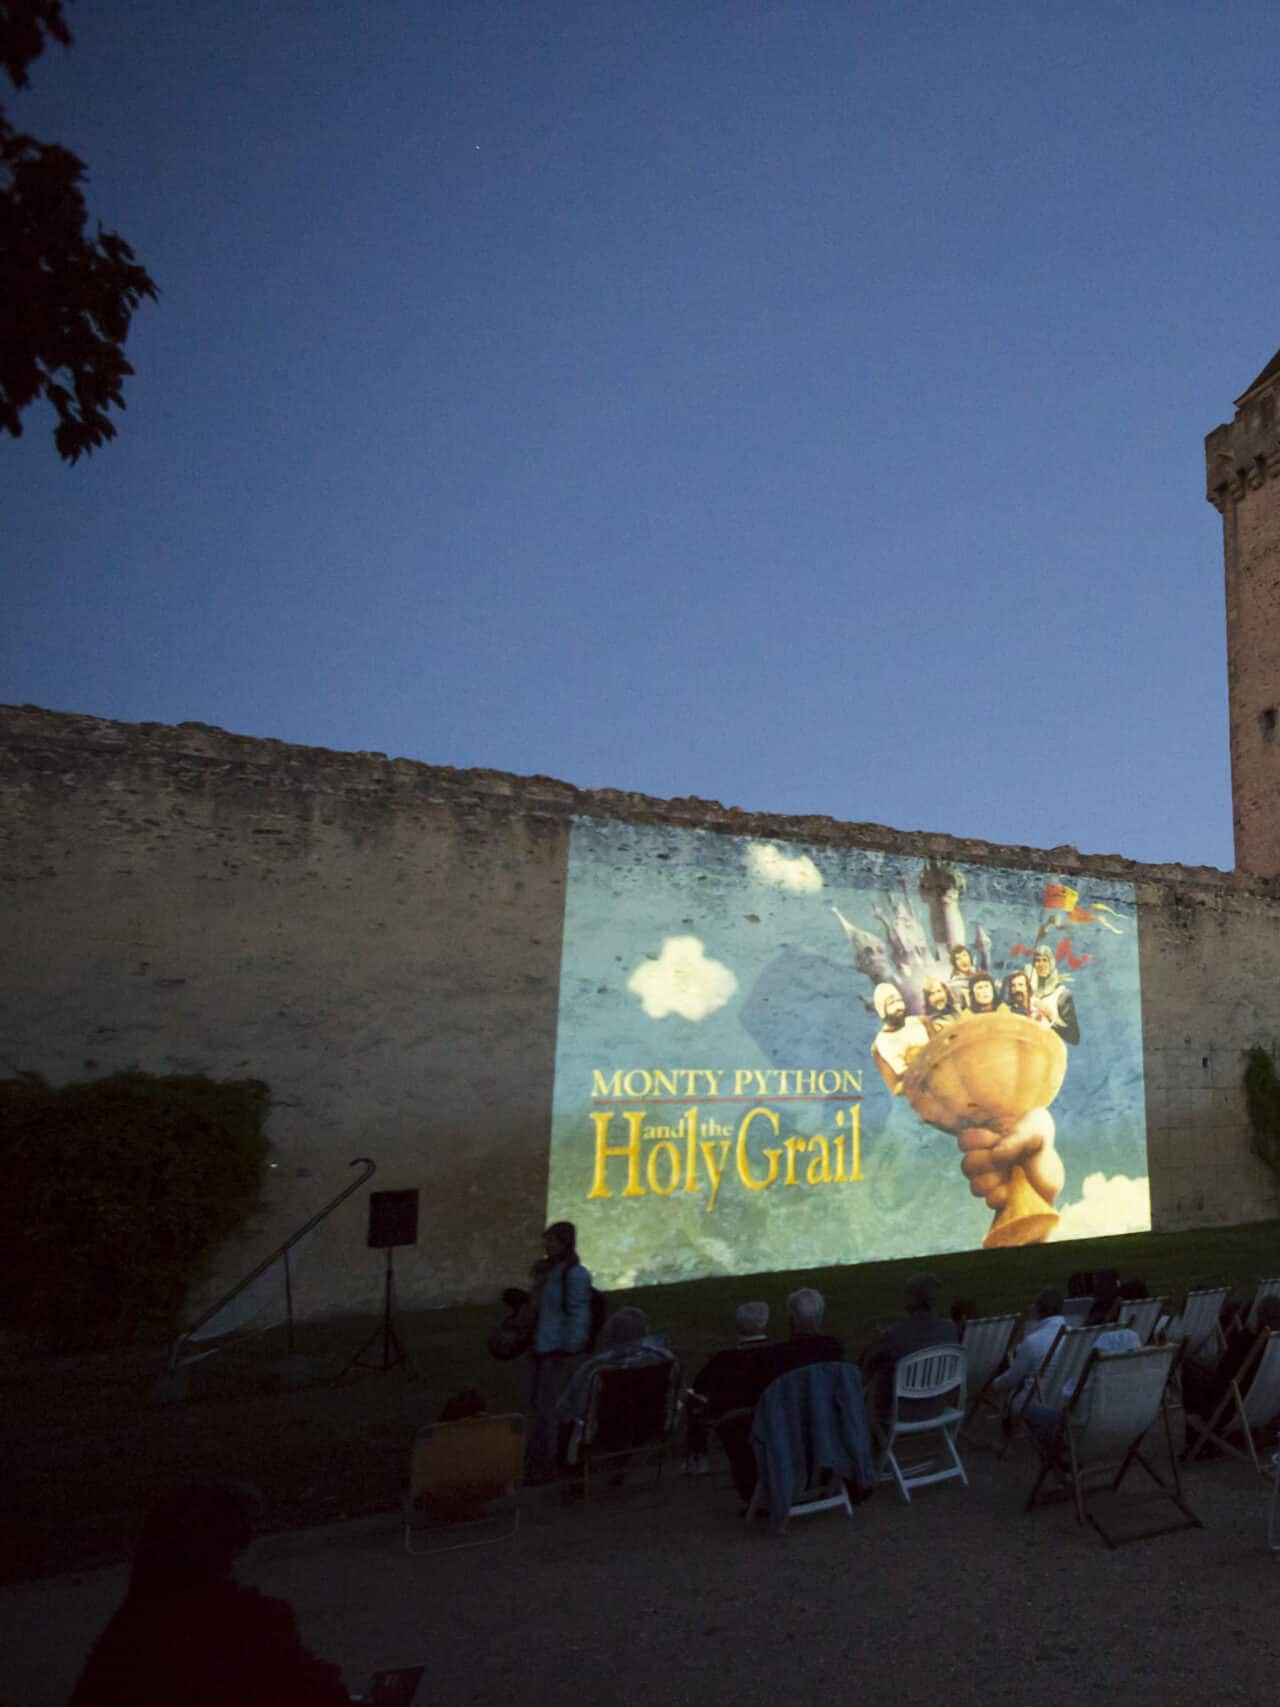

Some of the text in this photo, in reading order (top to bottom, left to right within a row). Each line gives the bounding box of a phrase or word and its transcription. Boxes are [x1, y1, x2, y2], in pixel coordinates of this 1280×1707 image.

[591, 1069, 863, 1097] MONTY PYTHON
[643, 1119, 734, 1139] and the
[586, 1103, 864, 1213] Holy Grail
